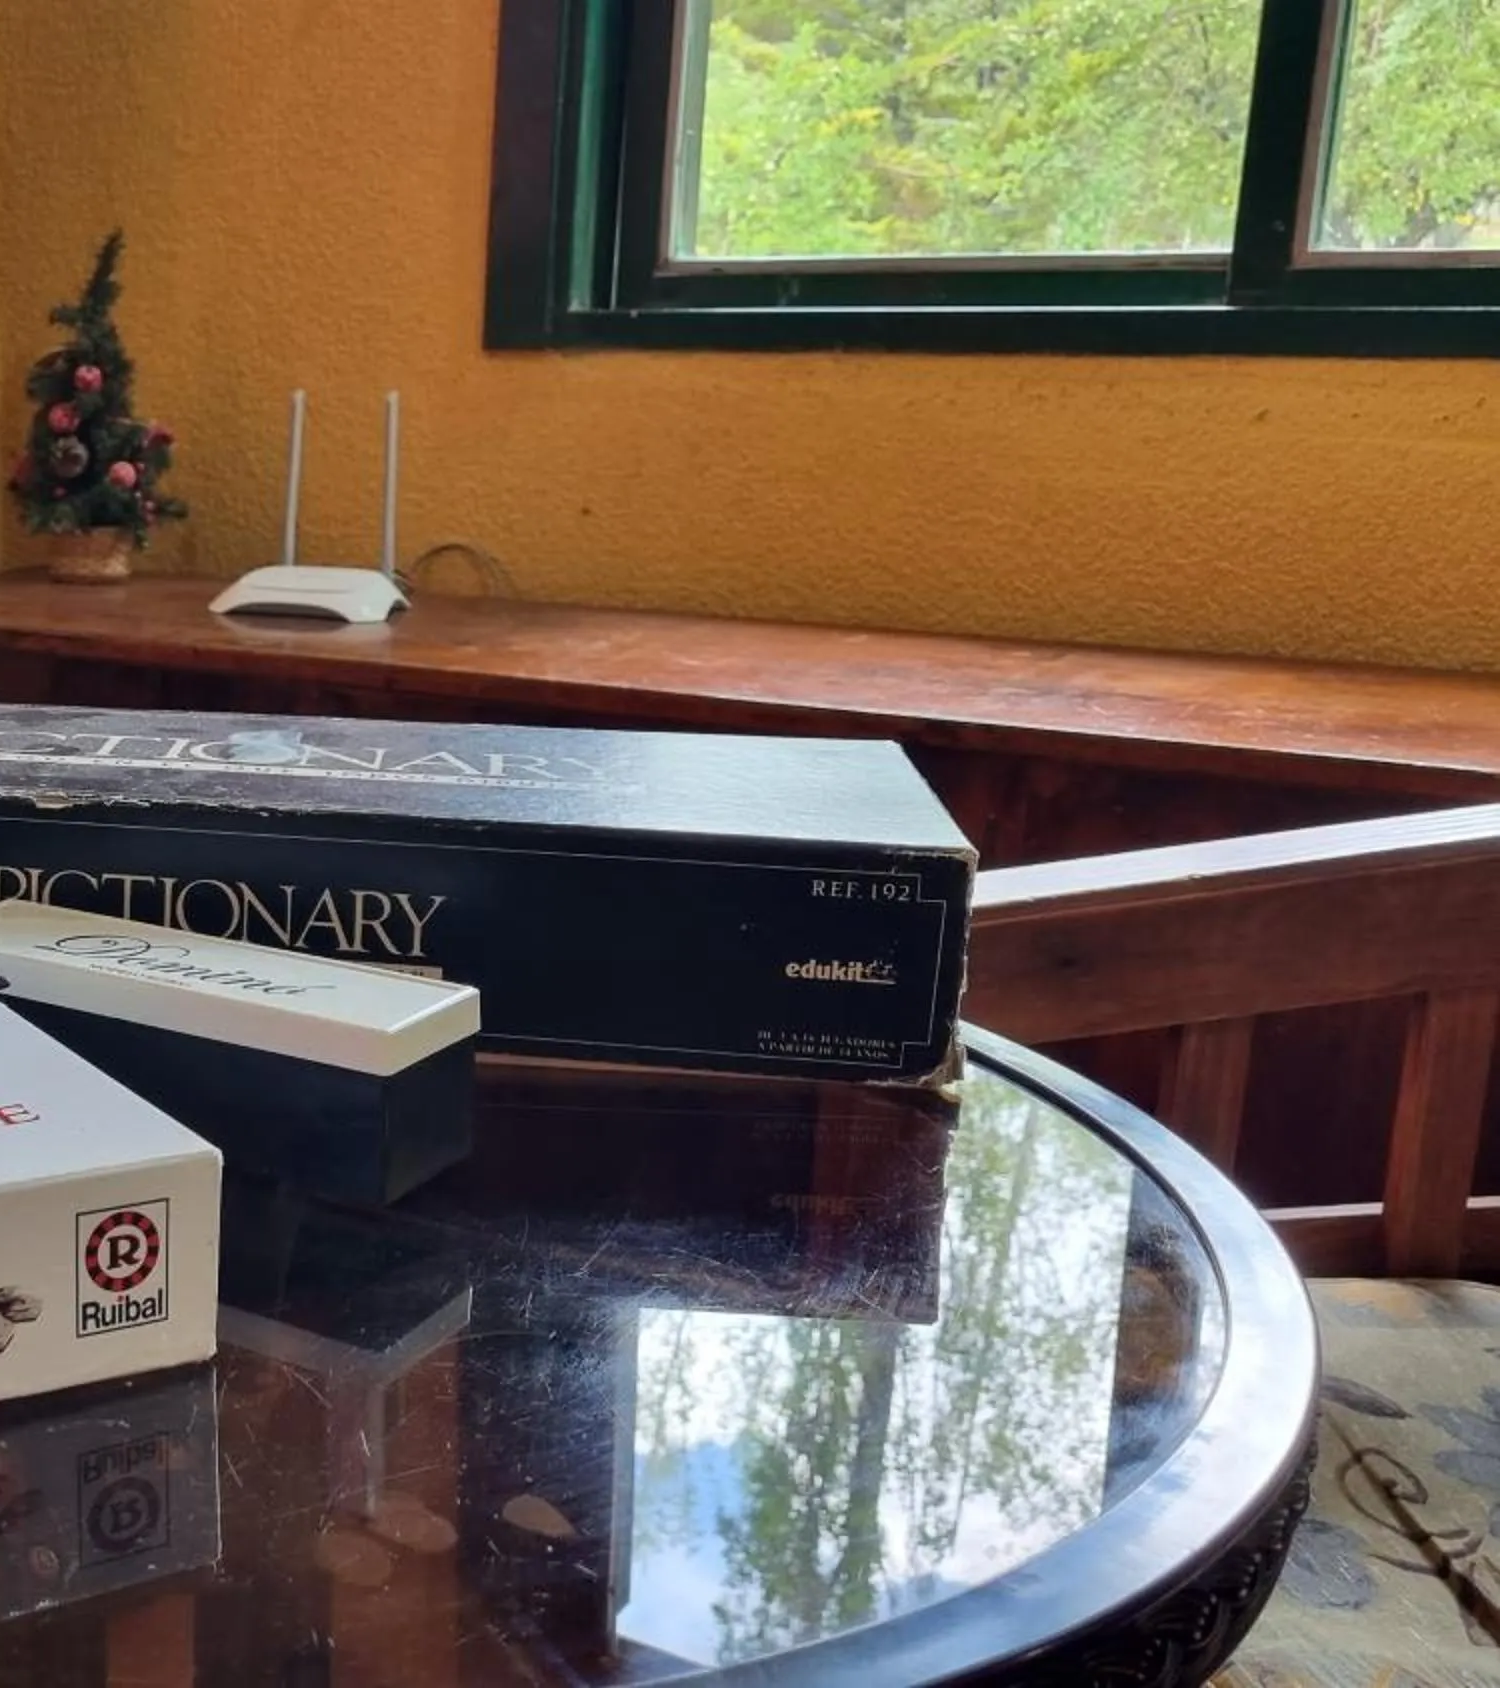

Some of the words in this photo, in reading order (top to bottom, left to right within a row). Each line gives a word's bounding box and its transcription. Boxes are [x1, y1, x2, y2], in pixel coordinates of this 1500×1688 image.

[812, 879, 863, 900] REF.
[870, 882, 912, 901] 192
[81, 1288, 163, 1332] Ruibal
